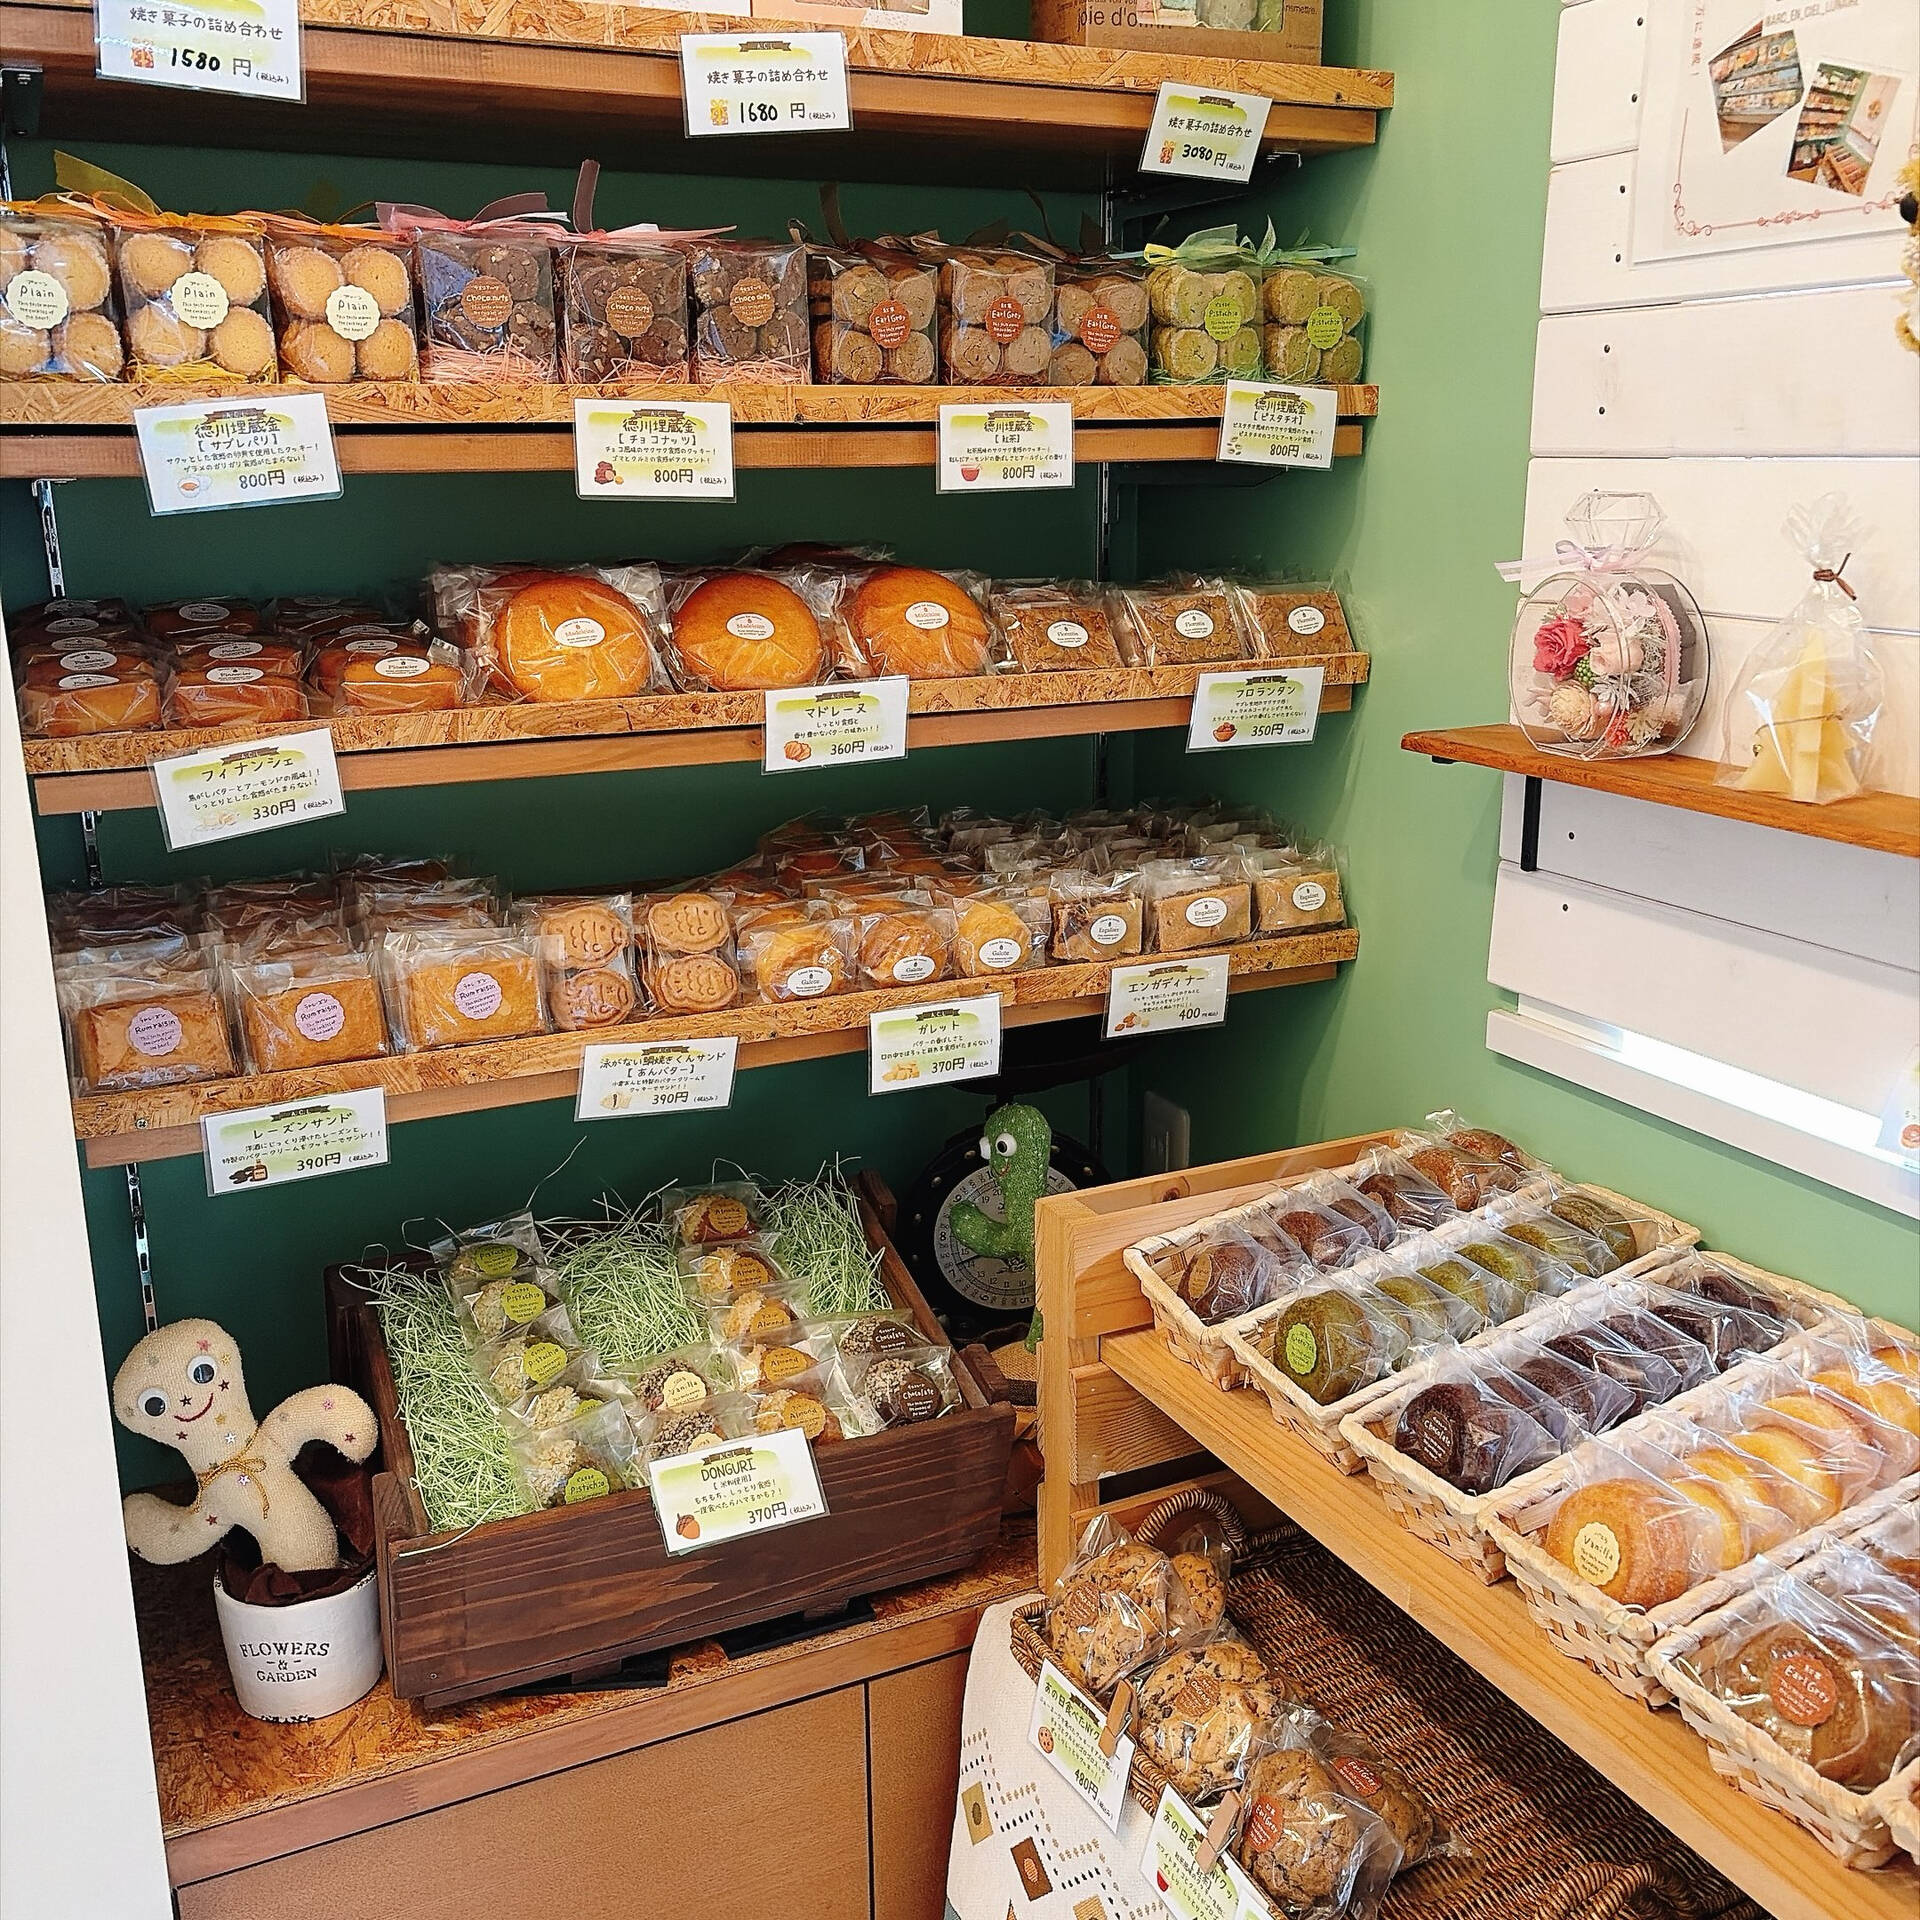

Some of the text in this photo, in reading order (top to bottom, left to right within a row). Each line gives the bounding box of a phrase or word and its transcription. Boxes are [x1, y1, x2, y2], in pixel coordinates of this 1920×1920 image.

[130, 7, 283, 40] 焼き菓子の詰め合わせ
[170, 48, 221, 71] 1580
[707, 69, 828, 84] 焼き菓子の詰め合わせ
[740, 102, 777, 123] 1680
[1168, 116, 1252, 138] 焼き菓子の詰め合わせ
[1182, 144, 1213, 161] 3080
[19, 286, 55, 299] Plain
[183, 287, 216, 299] Plain
[338, 299, 368, 311] Plain
[194, 416, 281, 439] 徳川埋蔵金
[622, 419, 697, 434] 徳川埋蔵金
[984, 421, 1035, 432] 徳川埋蔵金
[1270, 444, 1300, 458] 800円
[239, 469, 285, 489] 800円
[654, 469, 693, 483] 800円
[1002, 465, 1035, 480] 800円
[1236, 686, 1296, 698] フロランタン
[805, 703, 866, 718] マドレーヌ
[1251, 723, 1284, 737] 350円
[830, 740, 865, 756] 360円
[201, 757, 294, 782] フィナンシェ
[253, 798, 296, 820] 330円
[1128, 975, 1205, 993] エンガディナー
[1179, 1008, 1200, 1020] 400
[918, 1020, 960, 1035] ガレット
[931, 1057, 965, 1074] 370円
[651, 1091, 689, 1105] 390円
[253, 1112, 353, 1140] レーズンサンド
[296, 1152, 341, 1172] 390円
[670, 1381, 698, 1396] Vanilla
[701, 1458, 756, 1481] DONGURI
[570, 1481, 604, 1494] Pistachio
[748, 1501, 787, 1524] 370円
[1584, 1536, 1613, 1560] Vanilla
[240, 1642, 330, 1657] FLOWERS
[257, 1668, 317, 1682] GARDEN
[1074, 1768, 1099, 1800] 480円
